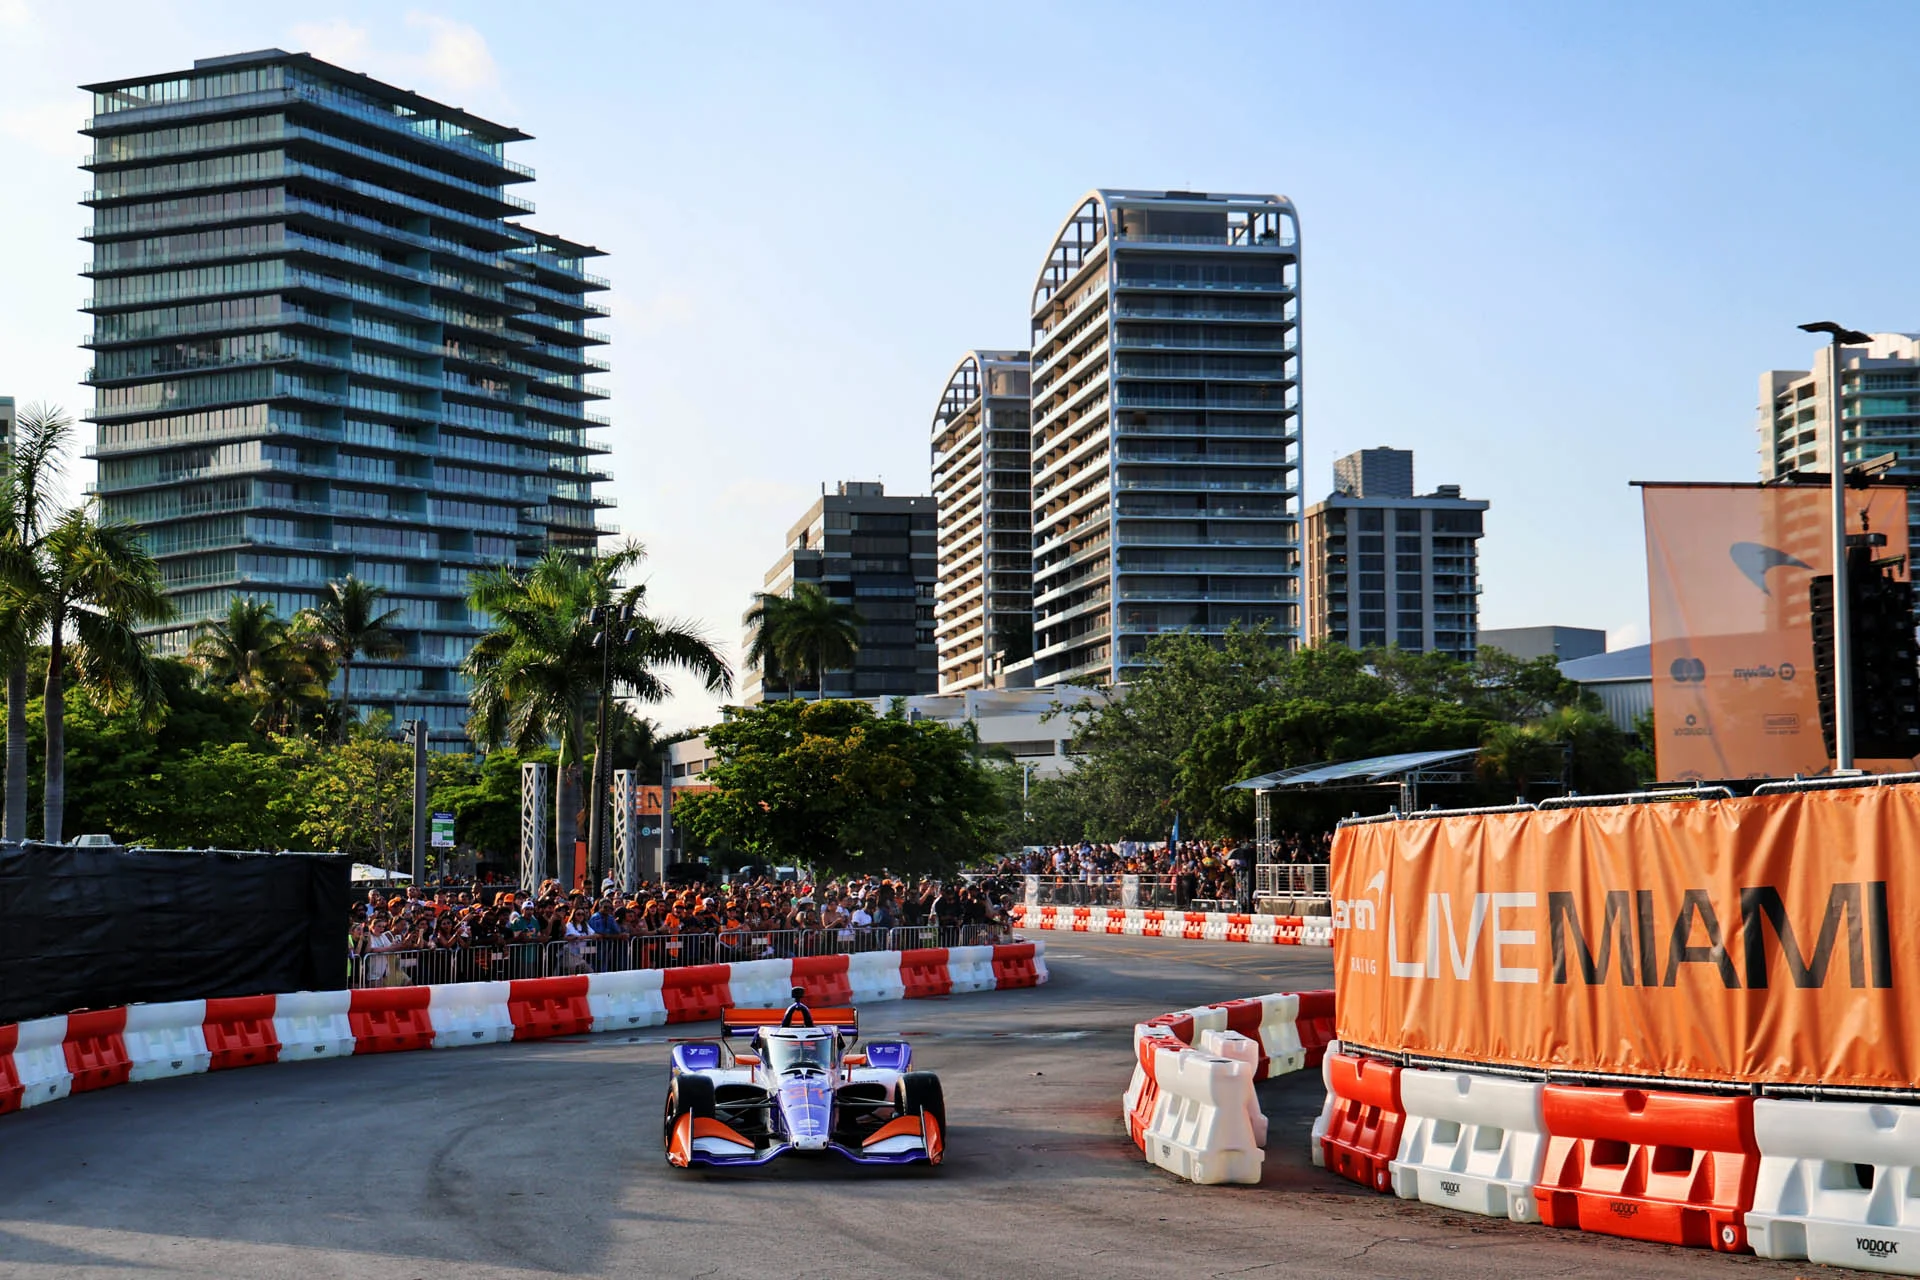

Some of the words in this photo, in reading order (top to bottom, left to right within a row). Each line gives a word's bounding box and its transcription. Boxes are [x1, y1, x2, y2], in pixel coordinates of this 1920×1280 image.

[1388, 892, 1538, 984] LIVE
[1548, 881, 1892, 989] MIAMI
[1610, 1201, 1639, 1214] YODOCK
[1856, 1237, 1898, 1254] YODOCK
